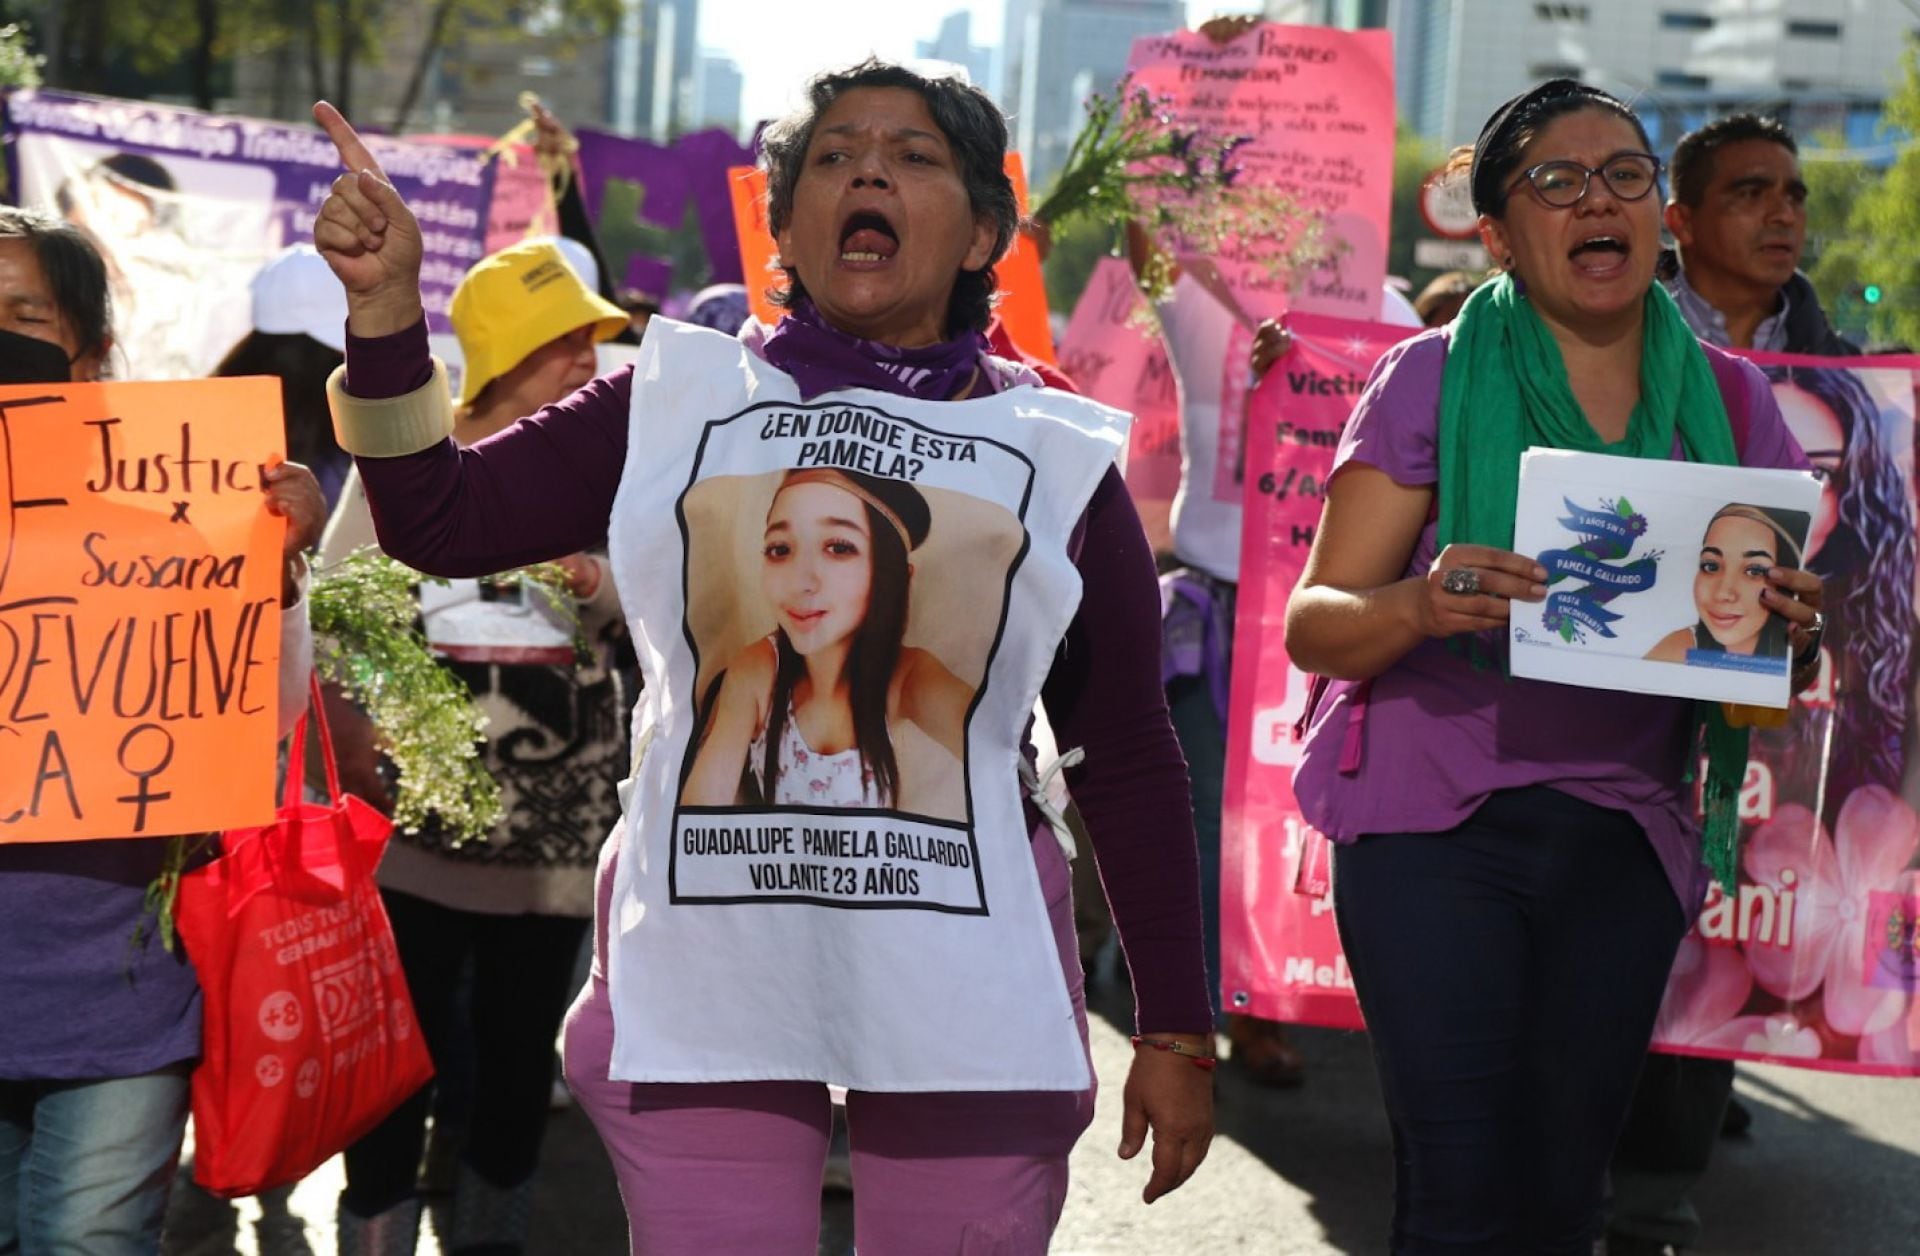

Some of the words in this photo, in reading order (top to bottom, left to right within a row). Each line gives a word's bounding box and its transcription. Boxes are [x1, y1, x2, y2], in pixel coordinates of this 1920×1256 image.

[760, 412, 813, 441] ¿EN
[911, 431, 978, 463] ESTÁ
[797, 439, 924, 482] PAMELA?
[80, 532, 245, 588] Susana
[1557, 558, 1592, 576] PAMELA
[1594, 568, 1642, 584] GALLARDO
[683, 827, 795, 855] GUADALUPE
[803, 830, 879, 859] PAMELA
[885, 831, 971, 870] GALLARDO
[749, 863, 830, 893] VOLANTE
[833, 867, 857, 894] 23
[863, 862, 920, 896] AÑOS
